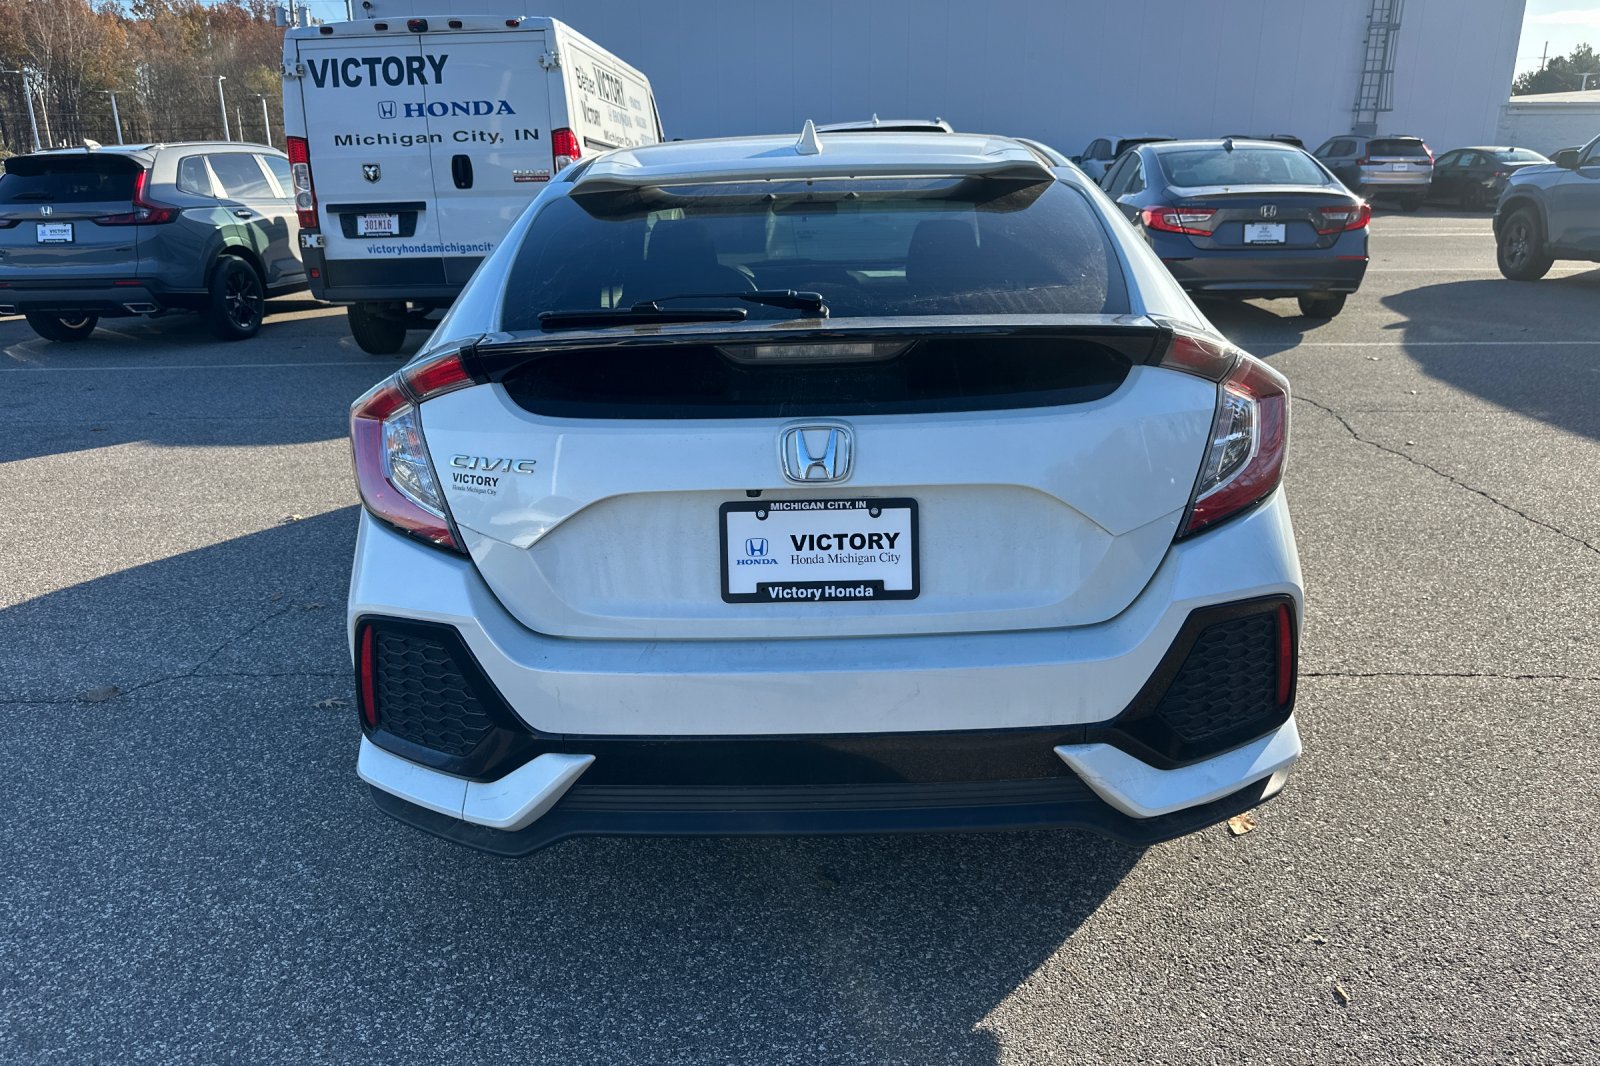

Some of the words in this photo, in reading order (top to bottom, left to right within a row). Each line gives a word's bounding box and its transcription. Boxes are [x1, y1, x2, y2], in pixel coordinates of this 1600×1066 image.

[307, 54, 448, 88] VICTORY
[403, 100, 517, 119] HONDA
[334, 134, 443, 147] Michigan
[453, 130, 505, 144] City,
[514, 129, 540, 141] IN
[367, 243, 493, 255] victoryhondamichigancit
[449, 453, 537, 474] CIVIC
[452, 472, 500, 487] VICTORY
[770, 501, 825, 511] MICHIGAN
[827, 500, 853, 510] CITY,
[855, 500, 867, 509] IN
[789, 532, 901, 551] VICTORY
[736, 558, 779, 566] HONDA
[790, 554, 825, 565] Honda
[827, 552, 876, 566] Michigan
[879, 551, 901, 564] City
[768, 587, 822, 600] Victory
[824, 585, 874, 597] Honda
